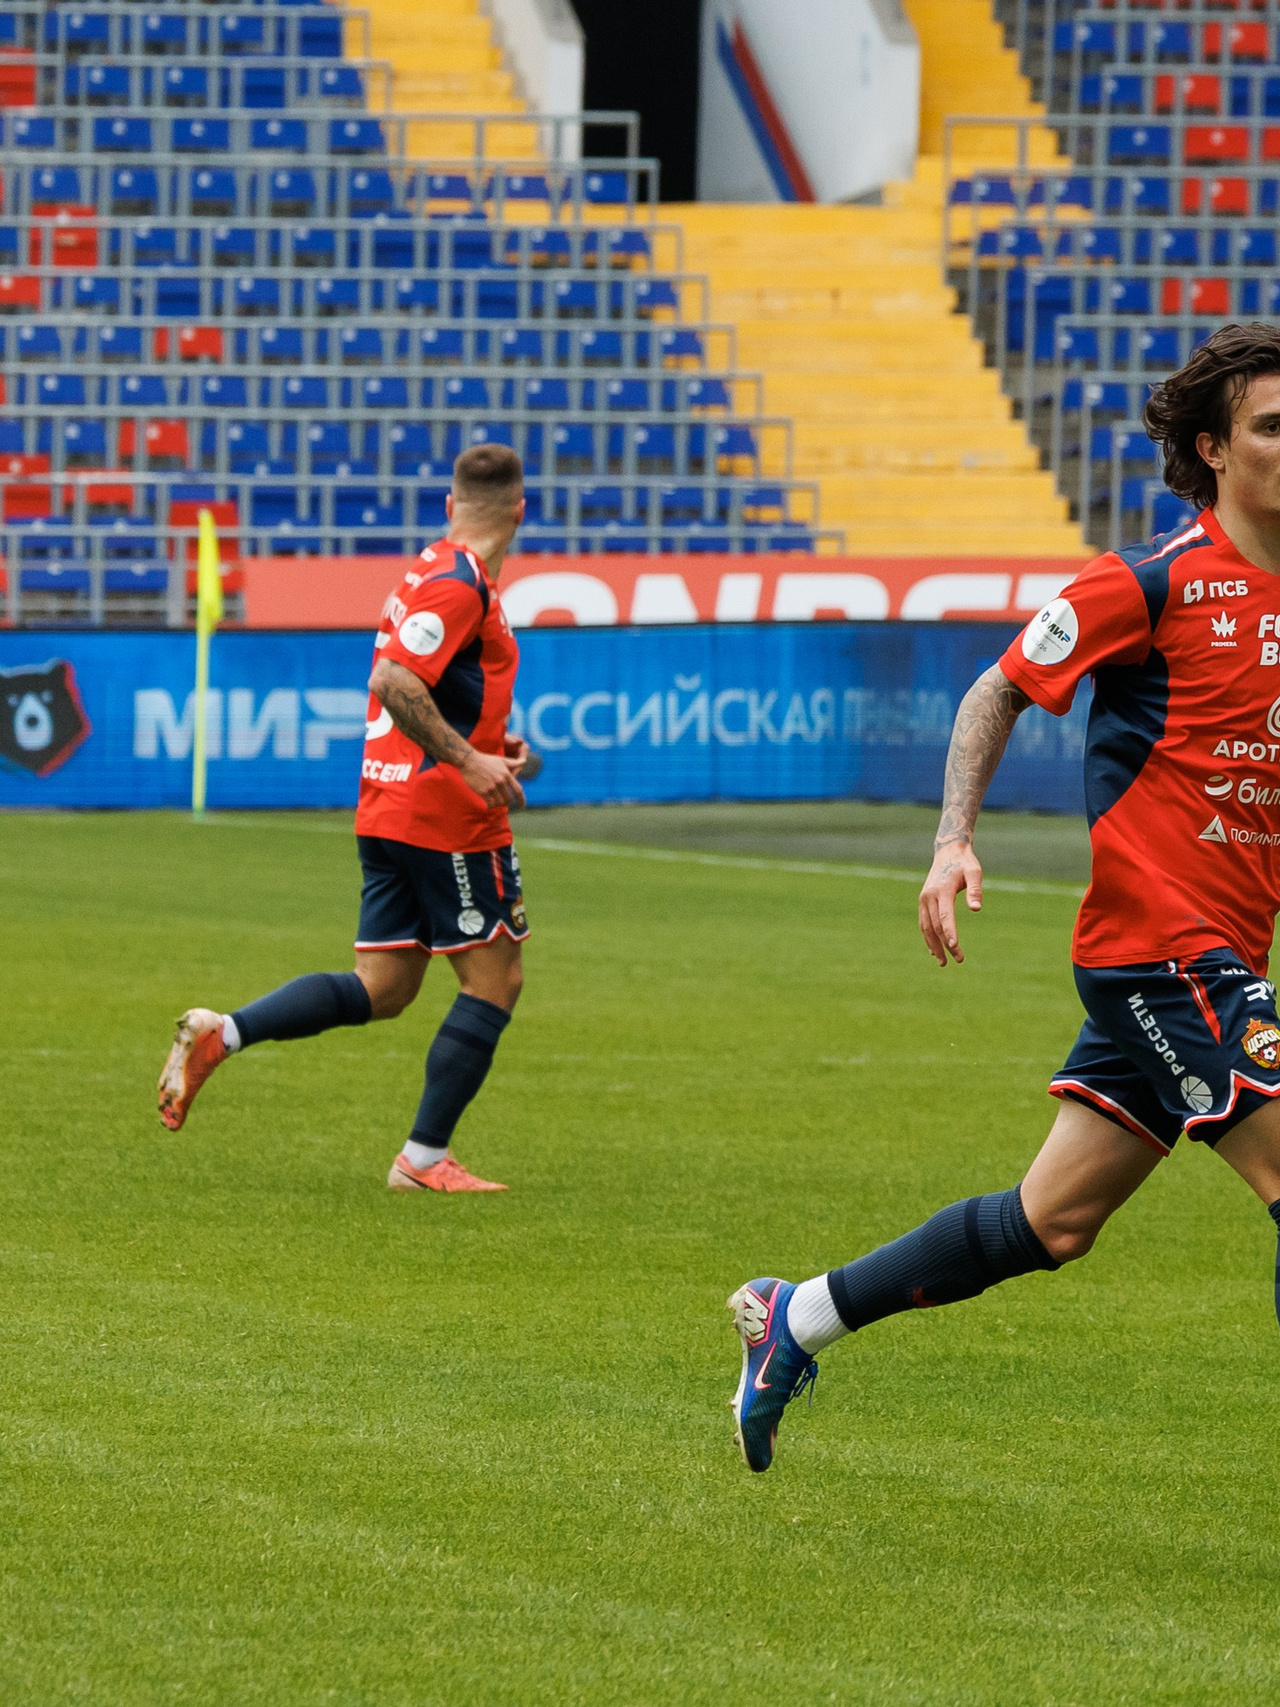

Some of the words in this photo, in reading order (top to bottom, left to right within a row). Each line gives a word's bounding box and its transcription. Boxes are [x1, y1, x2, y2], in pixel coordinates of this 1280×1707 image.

[1209, 580, 1249, 598] ПСБ
[507, 673, 835, 751] ССИЙСКАЯ
[362, 758, 412, 783] ССЕТИ
[1127, 991, 1187, 1076] РОССЕТИ
[1246, 1028, 1280, 1054] ЦСКА
